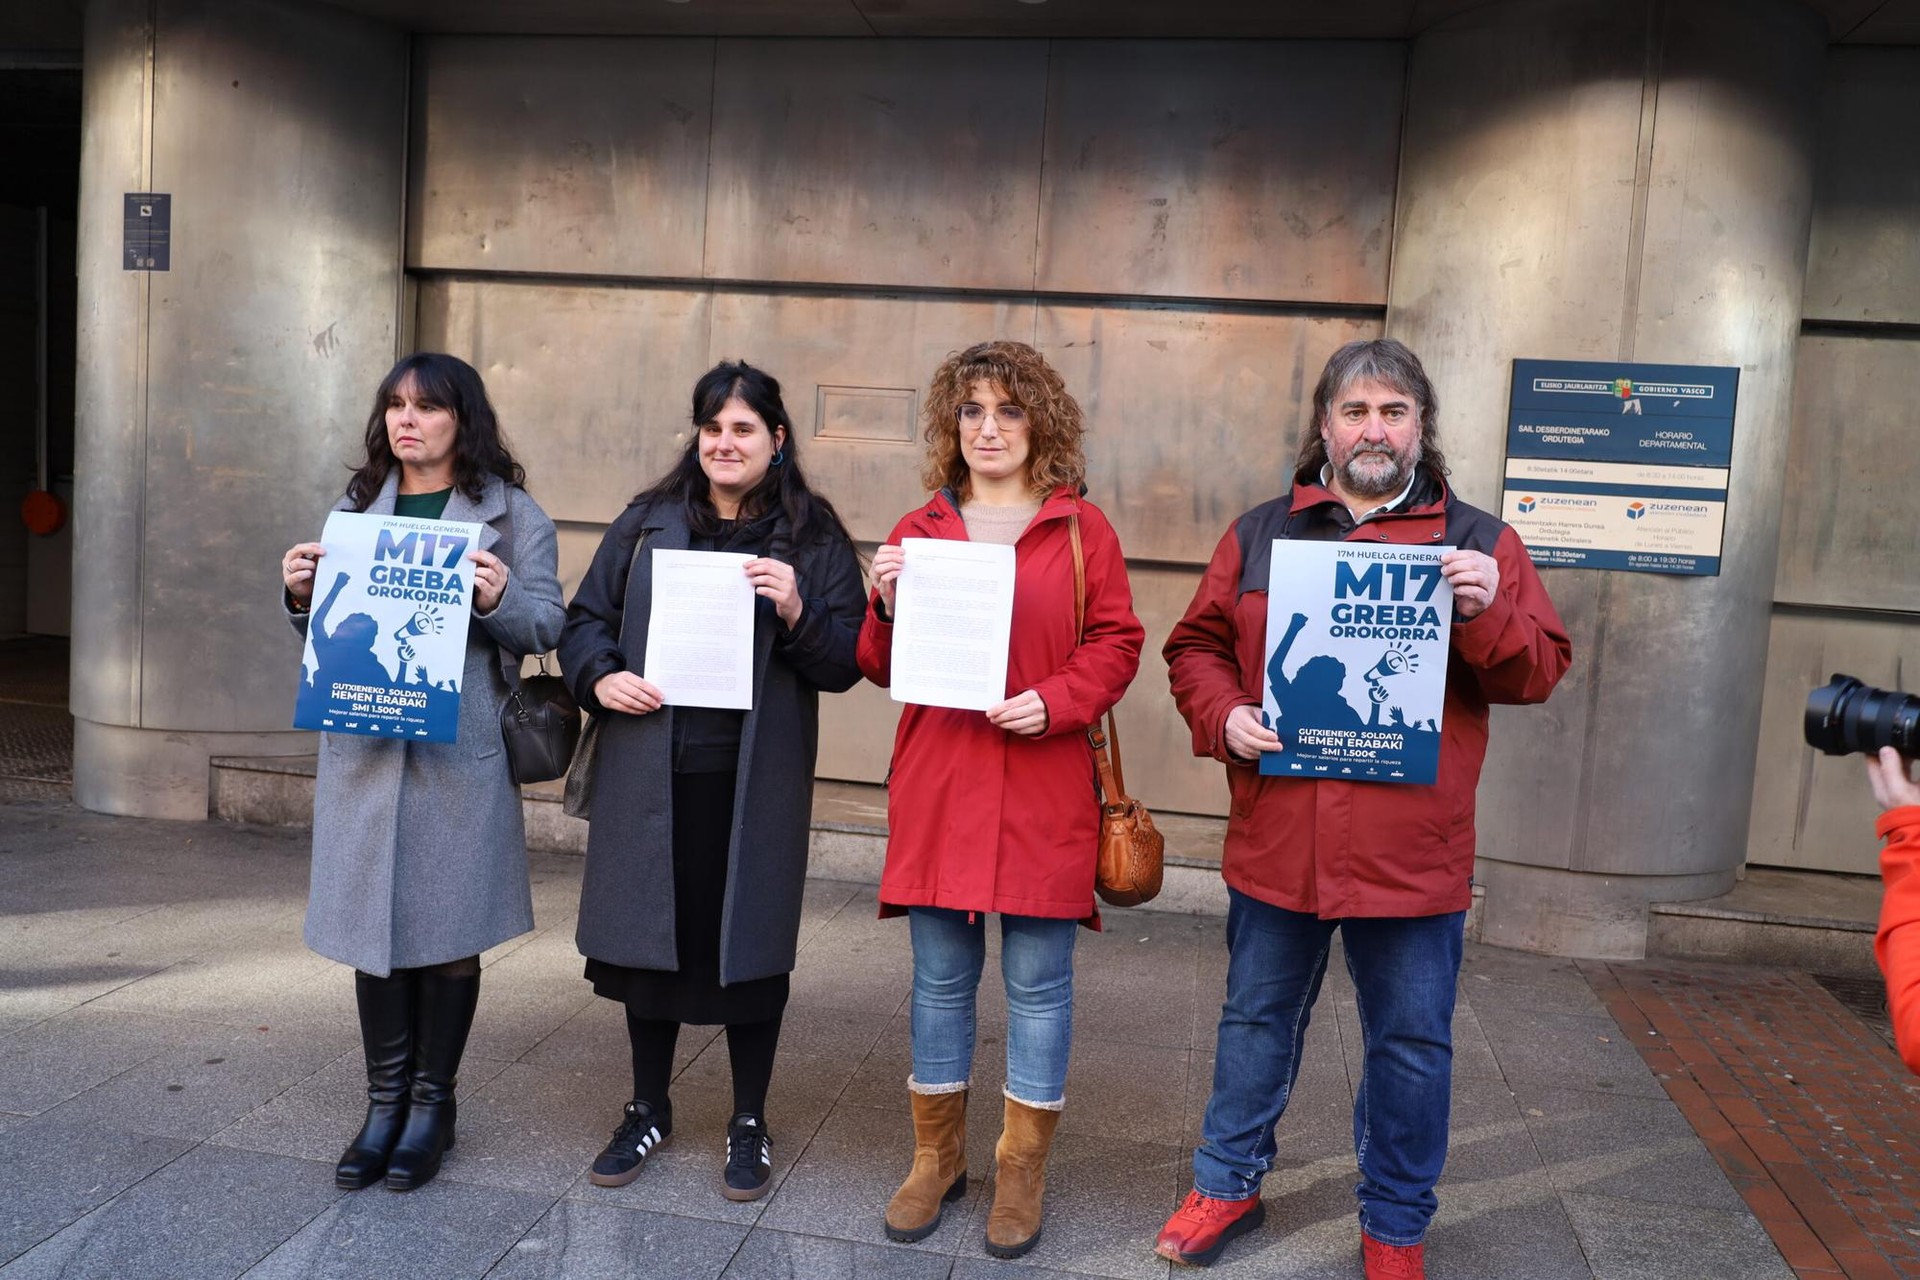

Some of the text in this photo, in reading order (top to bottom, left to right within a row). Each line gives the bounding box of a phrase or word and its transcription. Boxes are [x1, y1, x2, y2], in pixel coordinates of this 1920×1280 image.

[1541, 382, 1608, 392] EUSKO JAURLARITZA
[1639, 386, 1706, 396] GOBIERNO VASCO
[1518, 425, 1610, 437] SAIL DESBERDINETARAKO
[1655, 431, 1693, 441] HORARIO
[1542, 435, 1585, 445] ORDUTEGIA
[1639, 439, 1708, 451] DEPARTAMENTAL
[1539, 497, 1598, 507] zuzenean
[1649, 502, 1708, 513] zuzenean
[399, 522, 432, 531] HUELGA
[433, 526, 470, 535] GENERAL
[374, 528, 470, 570] M17
[1337, 550, 1355, 558] 17M
[1357, 551, 1397, 561] HUELGA
[1679, 558, 1696, 566] horas
[369, 564, 465, 594] GREBA
[1334, 560, 1444, 602] M17
[367, 584, 463, 607] OROKORRA
[1331, 603, 1442, 627] GREBA
[1329, 625, 1440, 641] OROKORRA
[332, 682, 428, 701] GUTXIENEKO SOLDATA
[331, 689, 427, 709] HEMEN ERABAKI
[352, 703, 403, 716] SMI 1.500€
[1298, 728, 1404, 742] GUTXIENEKO SOLDATA
[1298, 735, 1404, 751] HEMEN ERABAKI
[1296, 752, 1317, 760] Mejorar
[1353, 757, 1374, 765] repartir
[1321, 747, 1377, 760] SMI 1.500€
